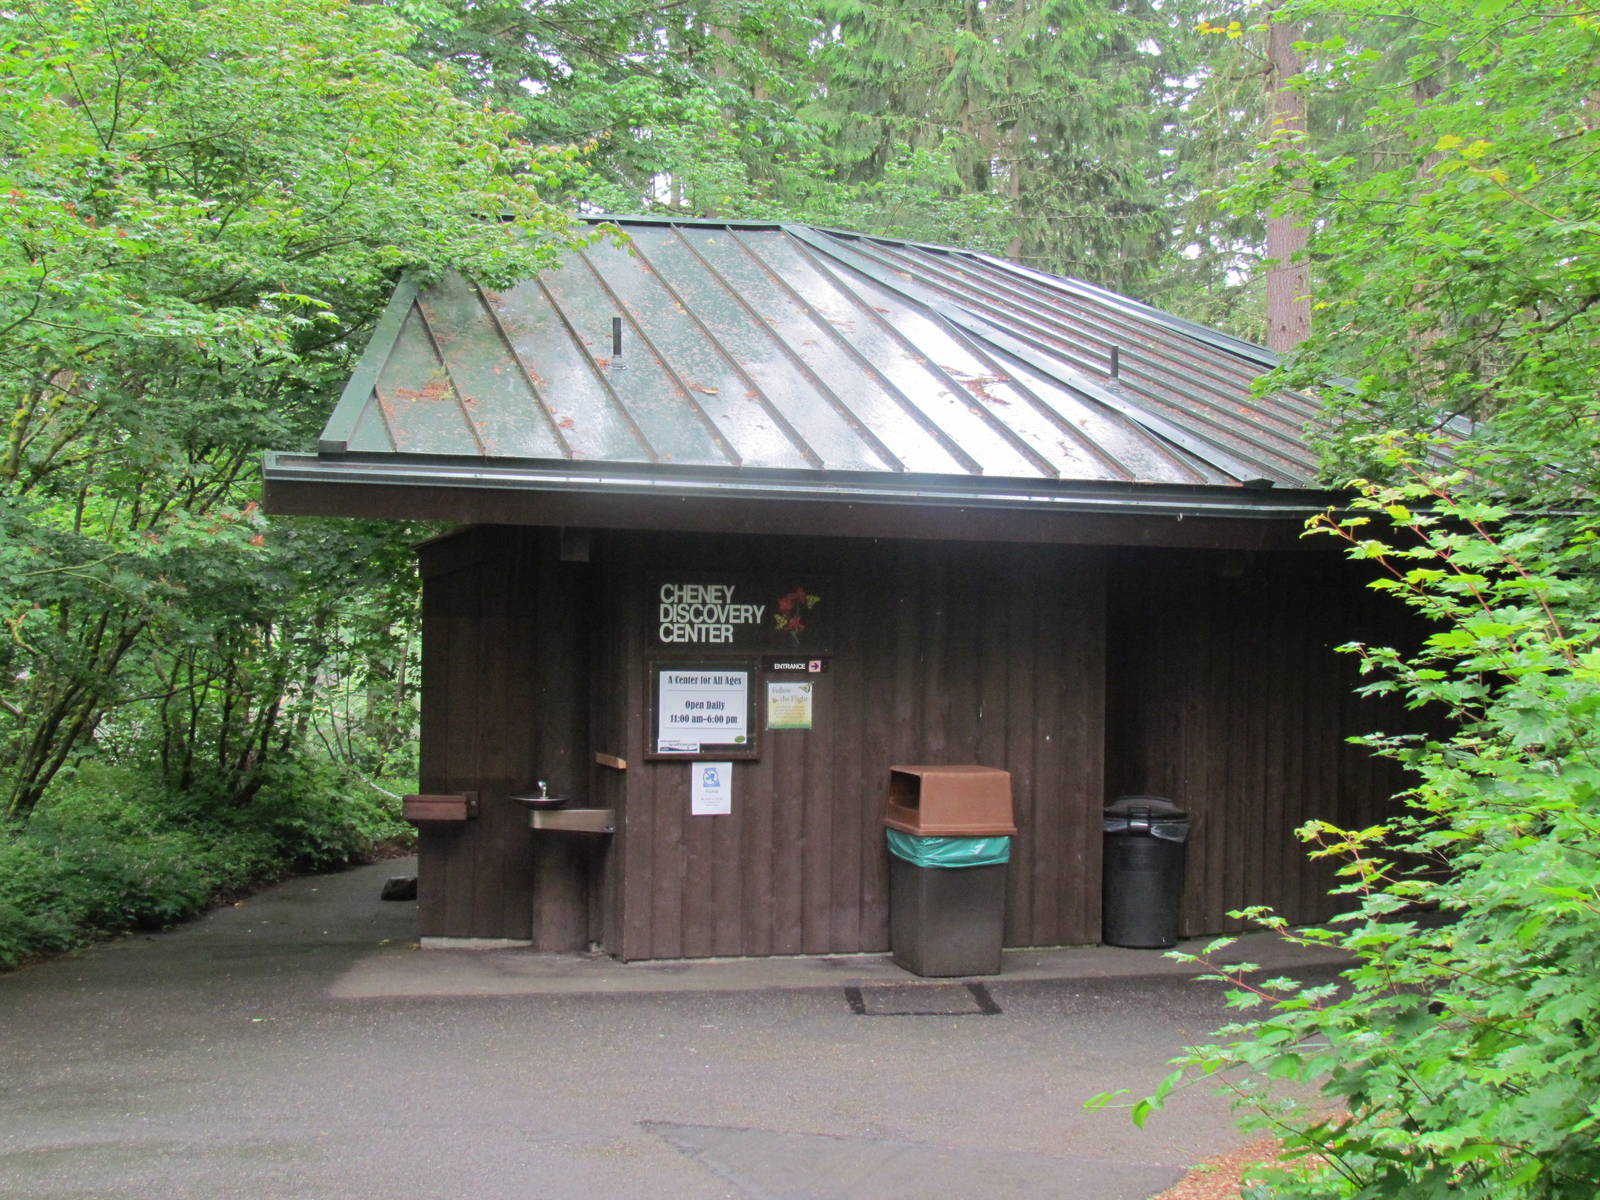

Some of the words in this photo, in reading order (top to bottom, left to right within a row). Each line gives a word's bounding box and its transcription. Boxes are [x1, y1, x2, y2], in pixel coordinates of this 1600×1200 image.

[660, 584, 735, 604] CHENEY
[660, 604, 765, 624] DISCOVERY
[659, 623, 734, 643] CENTER
[668, 675, 673, 684] A
[675, 675, 698, 684] Center
[700, 675, 711, 684] for
[713, 676, 723, 685] All
[725, 676, 742, 686] Ages
[685, 700, 704, 710] Open
[706, 701, 725, 711] Daily
[670, 714, 690, 723] 11:00
[726, 716, 738, 725] pm
